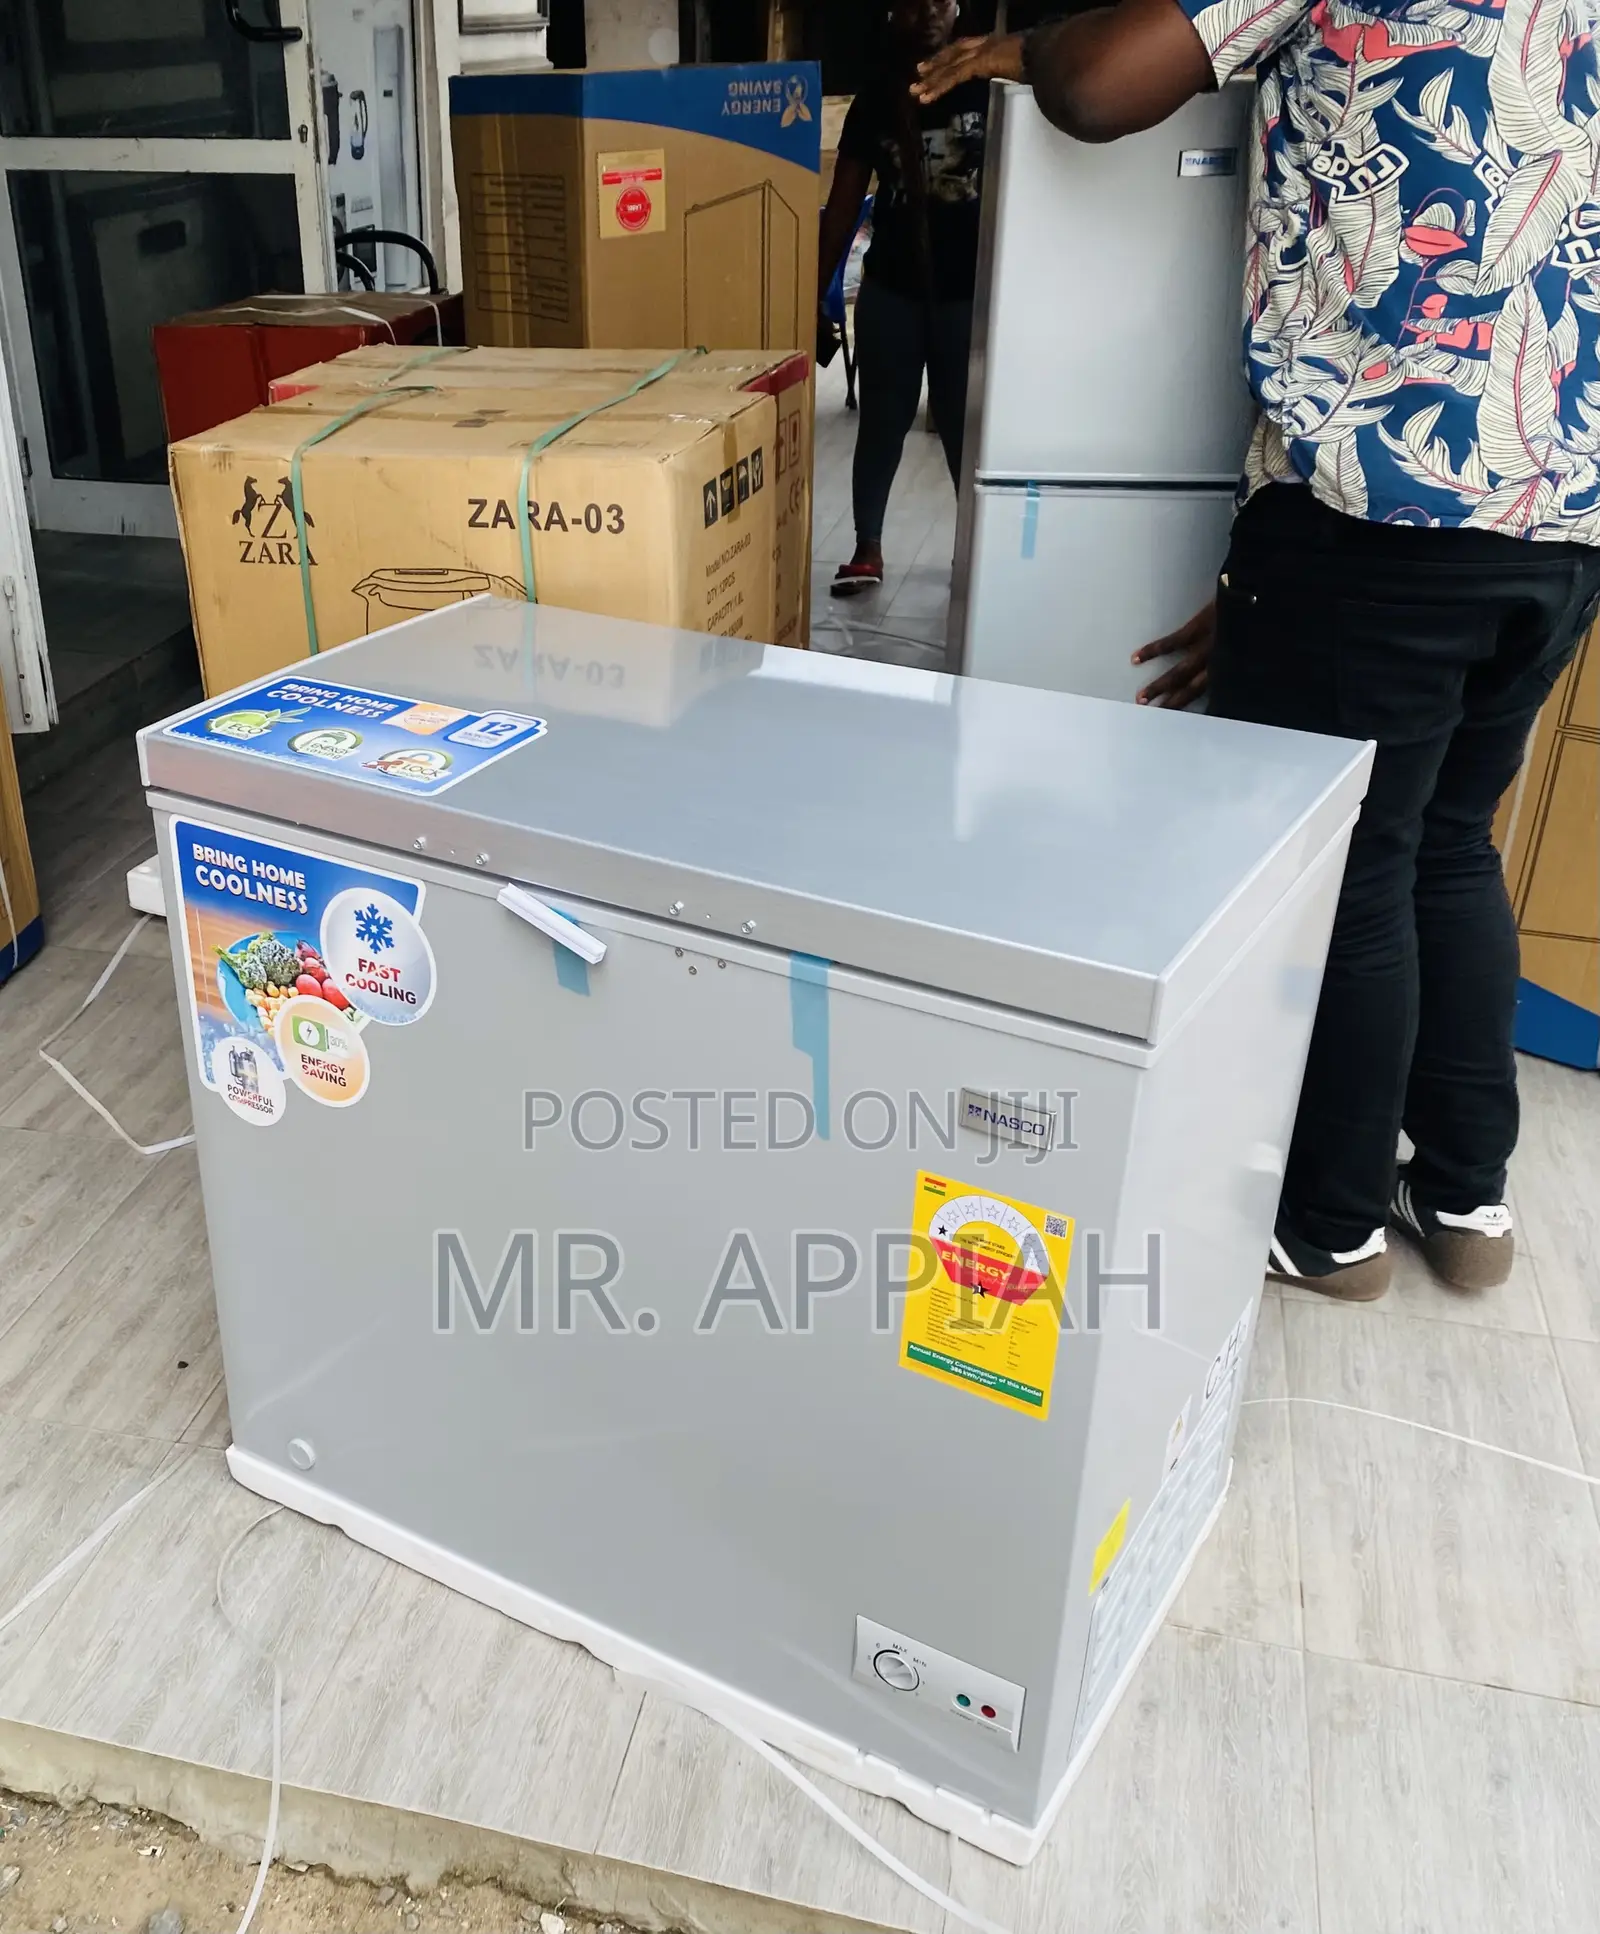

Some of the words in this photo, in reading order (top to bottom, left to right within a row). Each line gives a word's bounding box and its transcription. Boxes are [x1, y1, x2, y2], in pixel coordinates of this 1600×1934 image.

[728, 79, 783, 97] SAVING
[721, 98, 781, 116] ENERGY
[468, 498, 625, 534] ZARA-03
[266, 690, 385, 718] COOLNESS
[281, 683, 341, 699] BRING
[340, 694, 400, 711] HOME
[476, 721, 518, 737] 12
[192, 843, 248, 874] BRING
[252, 860, 306, 890] HOME
[195, 865, 308, 915] COOLNESS
[358, 958, 402, 983] FAST
[345, 974, 417, 1005] COOLING
[301, 1053, 346, 1076] ENERGY
[302, 1064, 347, 1088] SAVING
[227, 1084, 275, 1108] POWERFUL
[228, 1093, 274, 1116] COMPRESSOR
[983, 1109, 1045, 1136] NASCO
[941, 1250, 1010, 1280] ENERGY
[909, 1344, 931, 1357] Annual
[932, 1353, 954, 1366] Energy
[954, 1360, 998, 1381] Consumption
[998, 1377, 1007, 1385] of
[1007, 1379, 1020, 1390] this
[1020, 1385, 1042, 1398] Model
[892, 1643, 908, 1654] MAX
[913, 1657, 928, 1668] MIN
